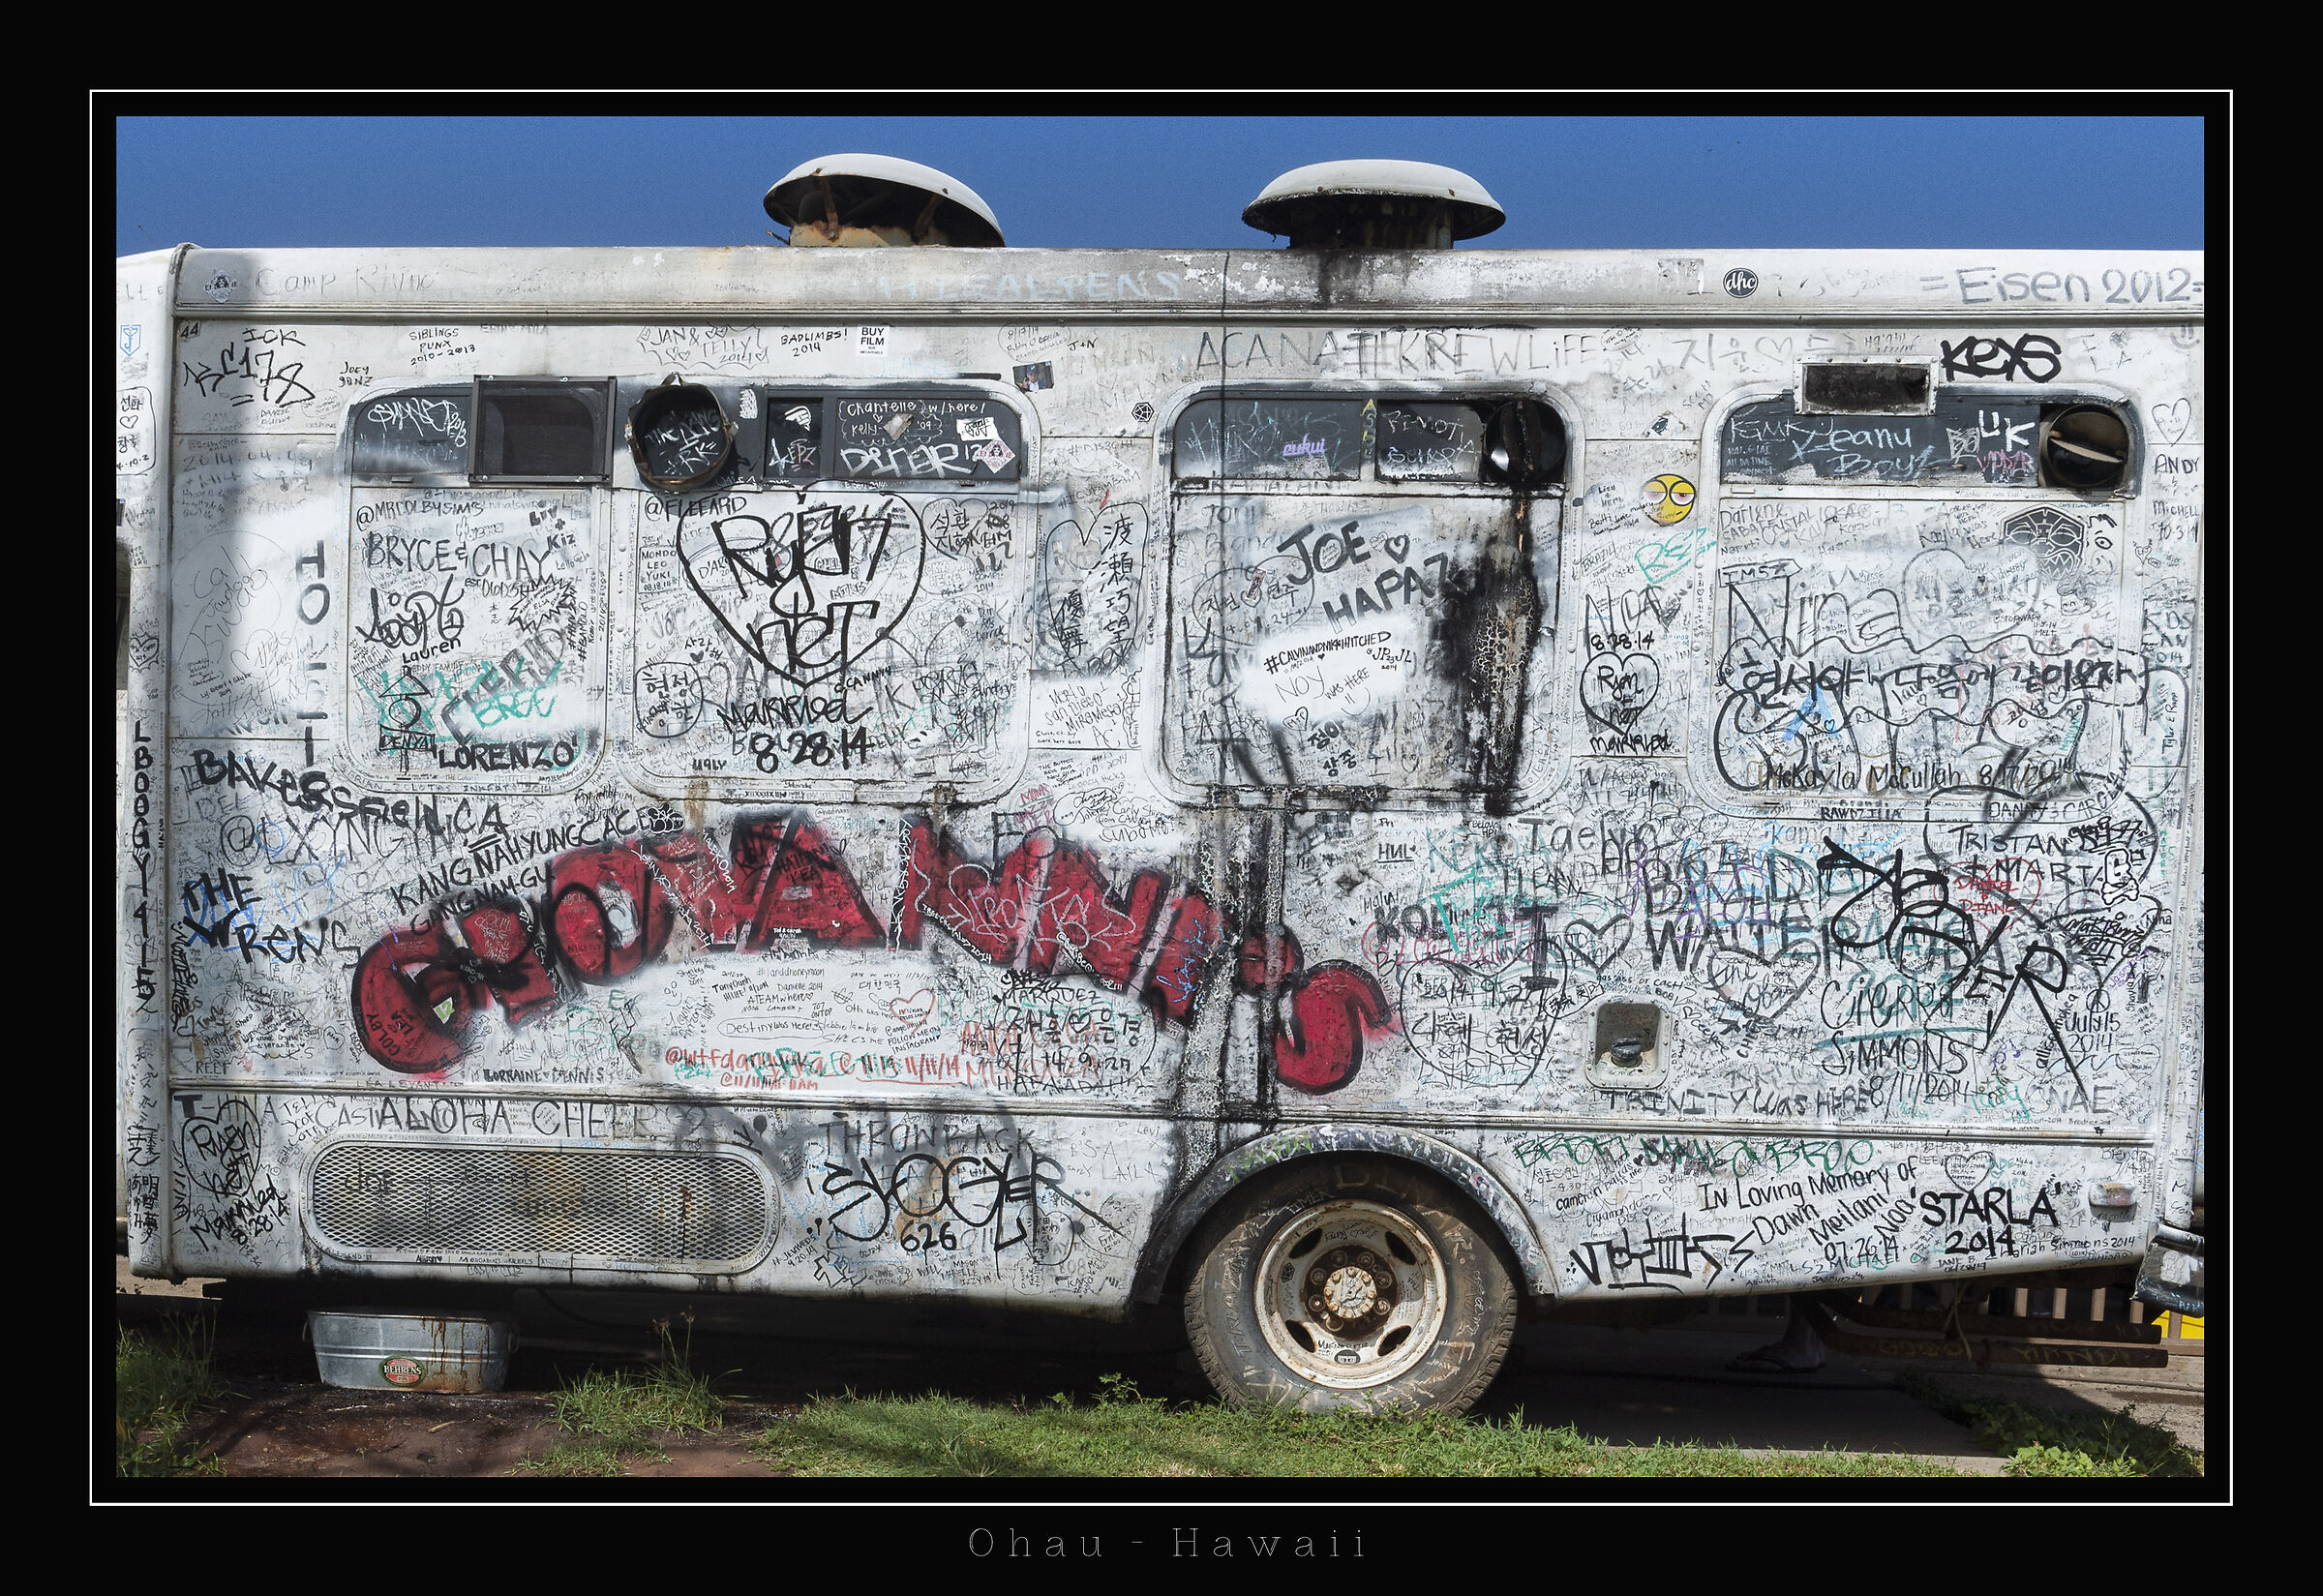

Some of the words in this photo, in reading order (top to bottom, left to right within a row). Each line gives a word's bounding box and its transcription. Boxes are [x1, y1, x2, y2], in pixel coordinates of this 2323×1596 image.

[1955, 266, 2090, 305] Eisen
[2101, 267, 2192, 305] 2012
[408, 327, 460, 341] SIBLINGS
[860, 327, 885, 337] BUY
[860, 337, 885, 346] FILM
[1276, 520, 1373, 586] JOE
[402, 637, 463, 664] Lauren
[1736, 1176, 1804, 1210] Loving
[1808, 1163, 1890, 1196] Memory
[1751, 1202, 1821, 1246] Dawn
[1944, 1224, 2016, 1258] 2014
[2111, 1235, 2135, 1248] 2014
[383, 1364, 422, 1376] BEHRENS
